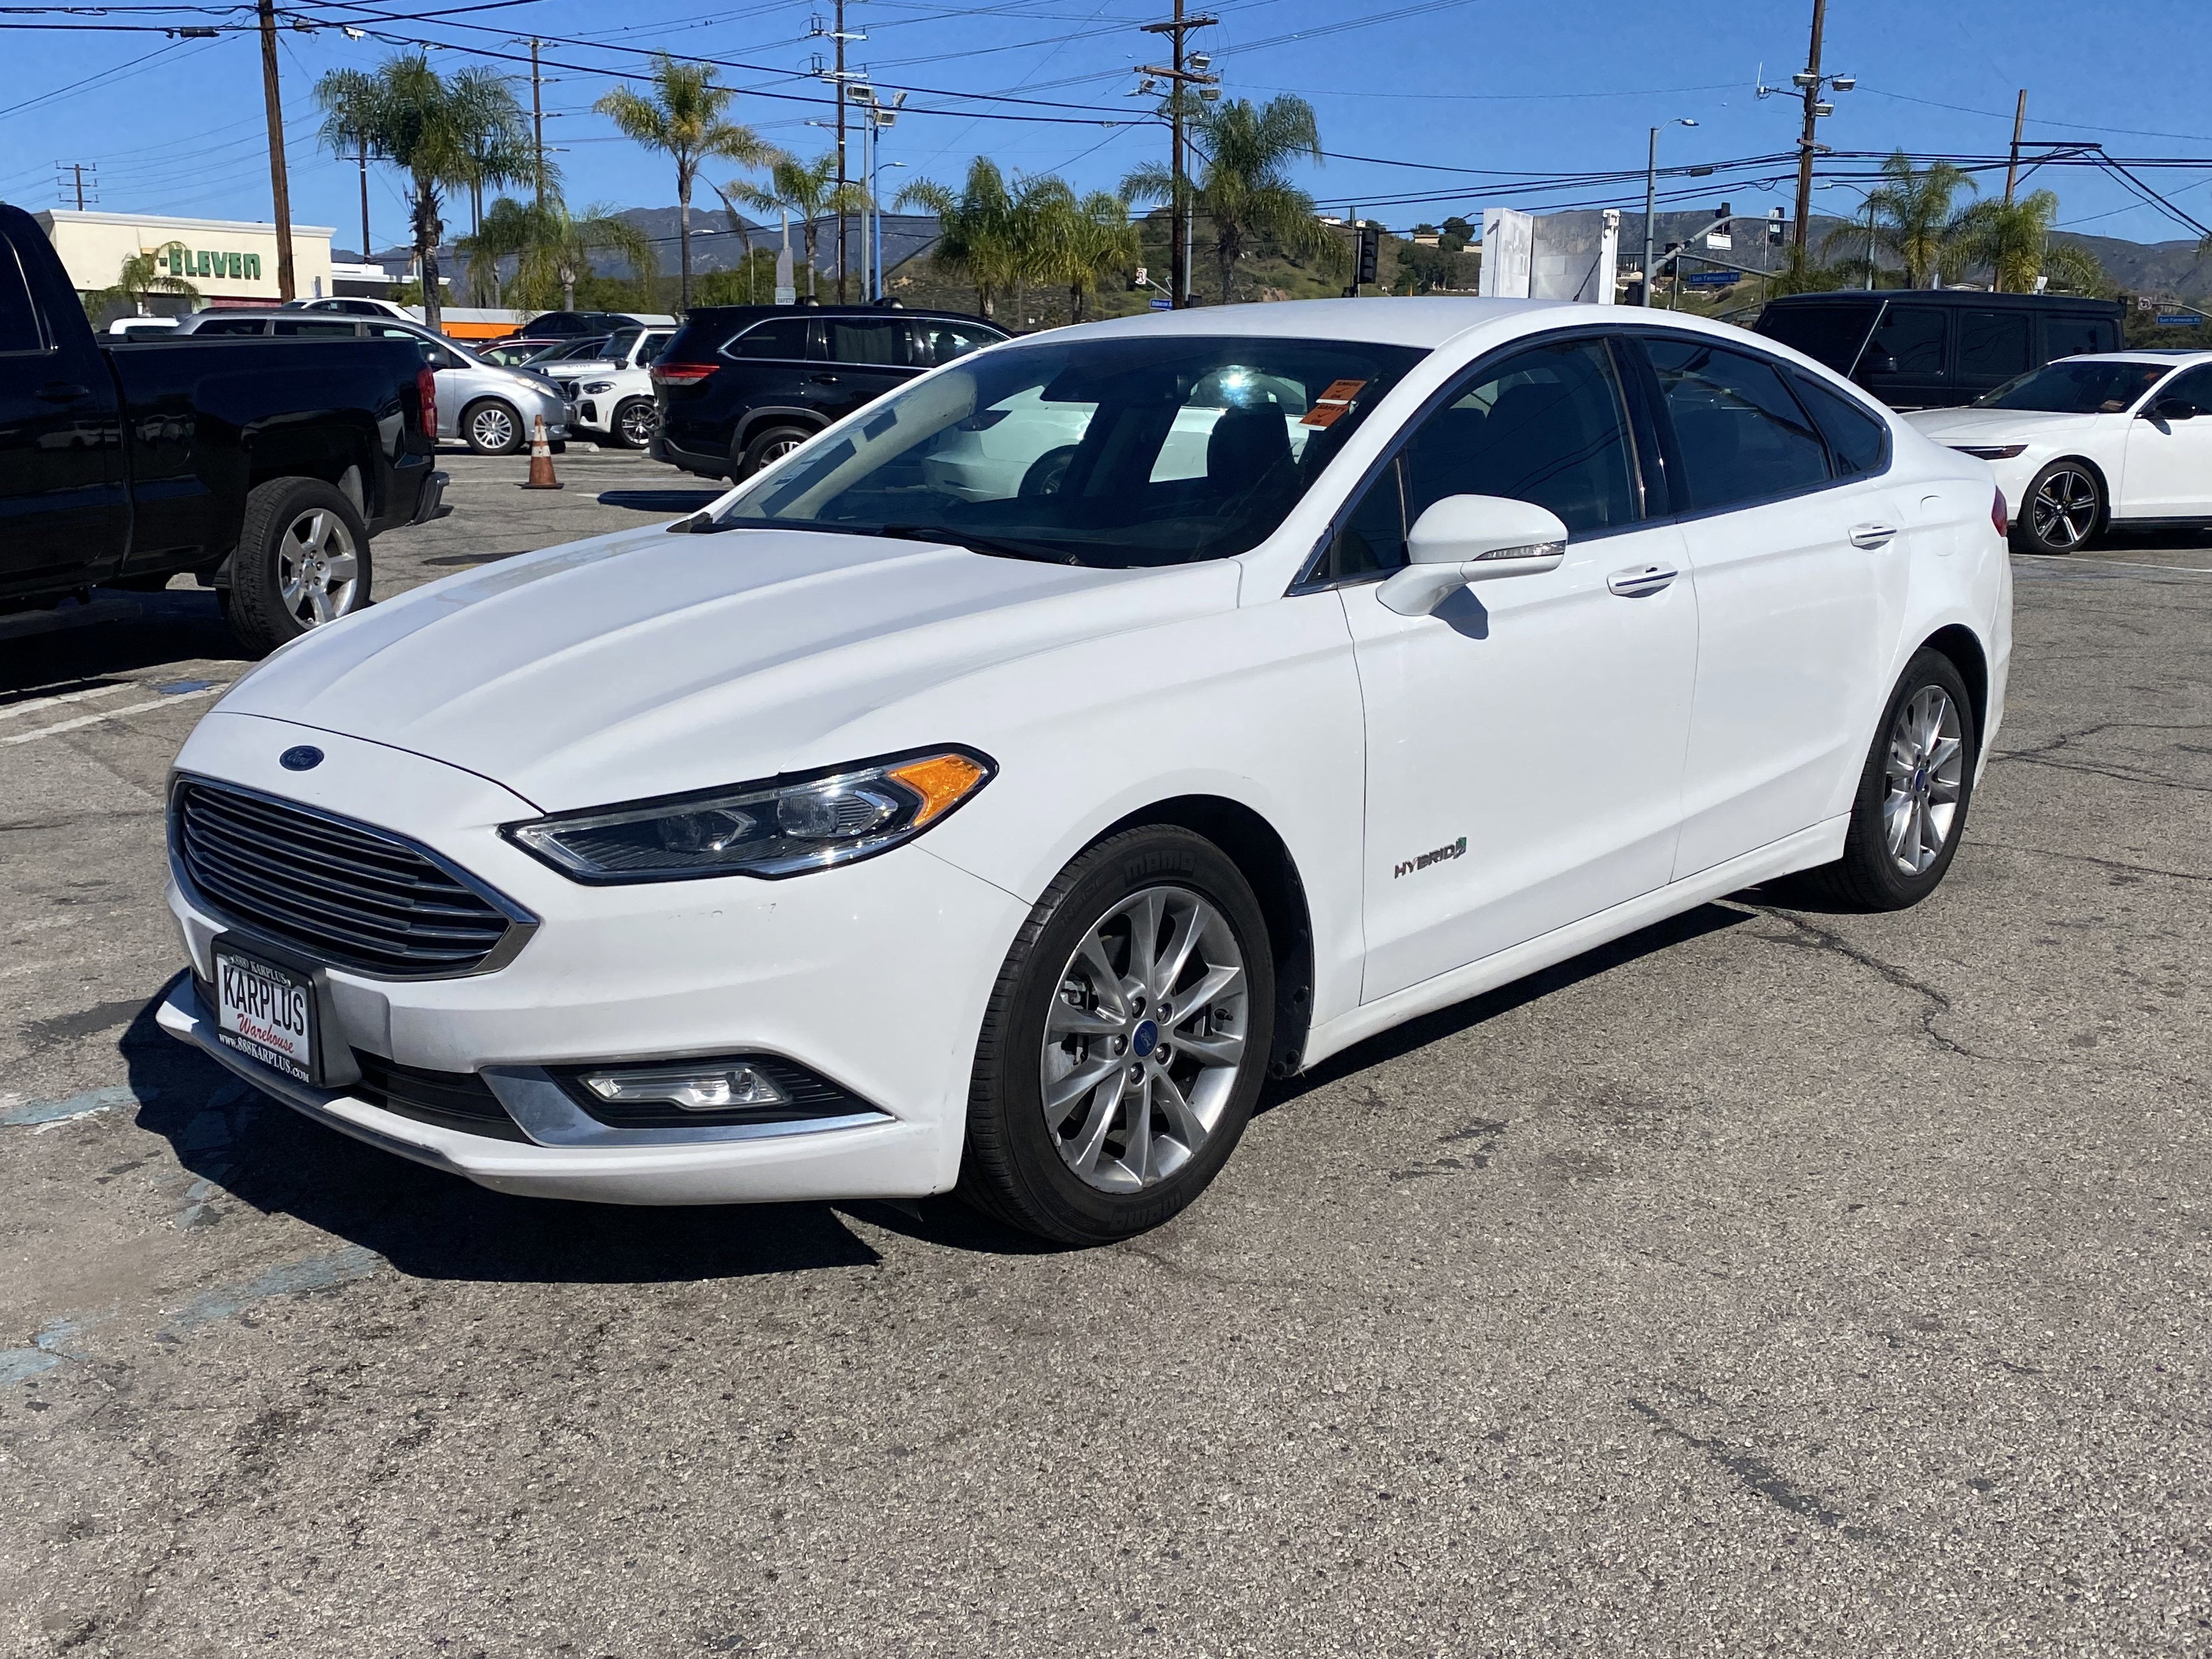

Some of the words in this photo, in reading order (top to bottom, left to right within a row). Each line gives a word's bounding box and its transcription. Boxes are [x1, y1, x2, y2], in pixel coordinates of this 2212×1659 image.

[1395, 844, 1455, 879] HYBRID
[250, 961, 287, 985] KARPLUS
[223, 964, 304, 1036] KARPLUS
[237, 1013, 295, 1054] Warehouse
